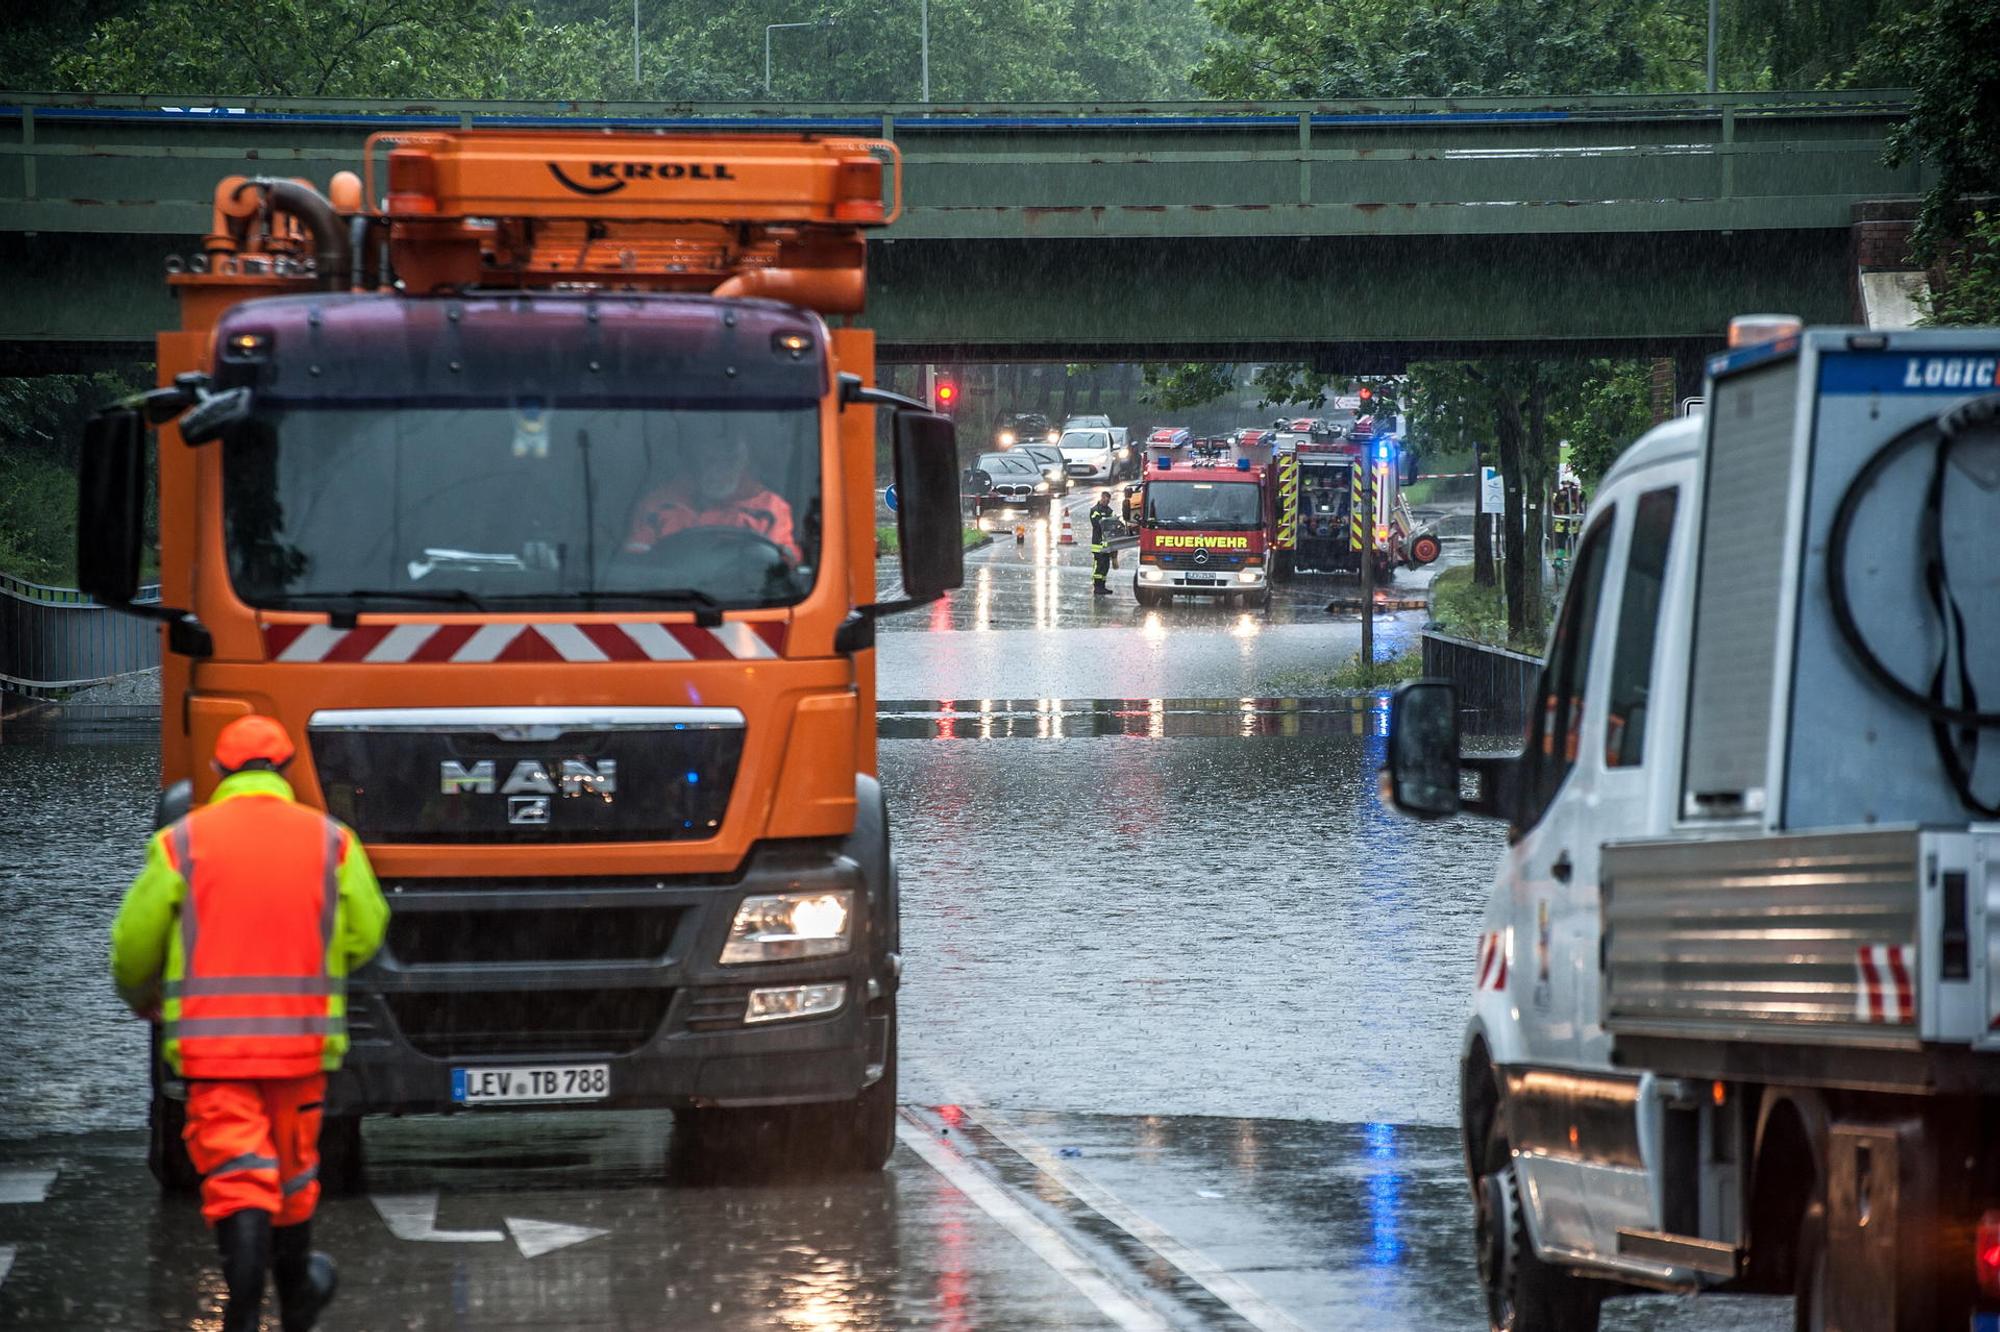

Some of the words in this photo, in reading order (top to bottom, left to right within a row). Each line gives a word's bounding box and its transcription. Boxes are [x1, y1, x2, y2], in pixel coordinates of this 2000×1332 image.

[589, 162, 735, 181] KROLL
[1904, 358, 2000, 387] LOGIC
[1155, 536, 1248, 548] FEUERWEHR
[441, 760, 617, 794] MAN
[467, 1073, 511, 1096] LEV
[529, 1071, 557, 1095] TB
[564, 1069, 605, 1093] 788
